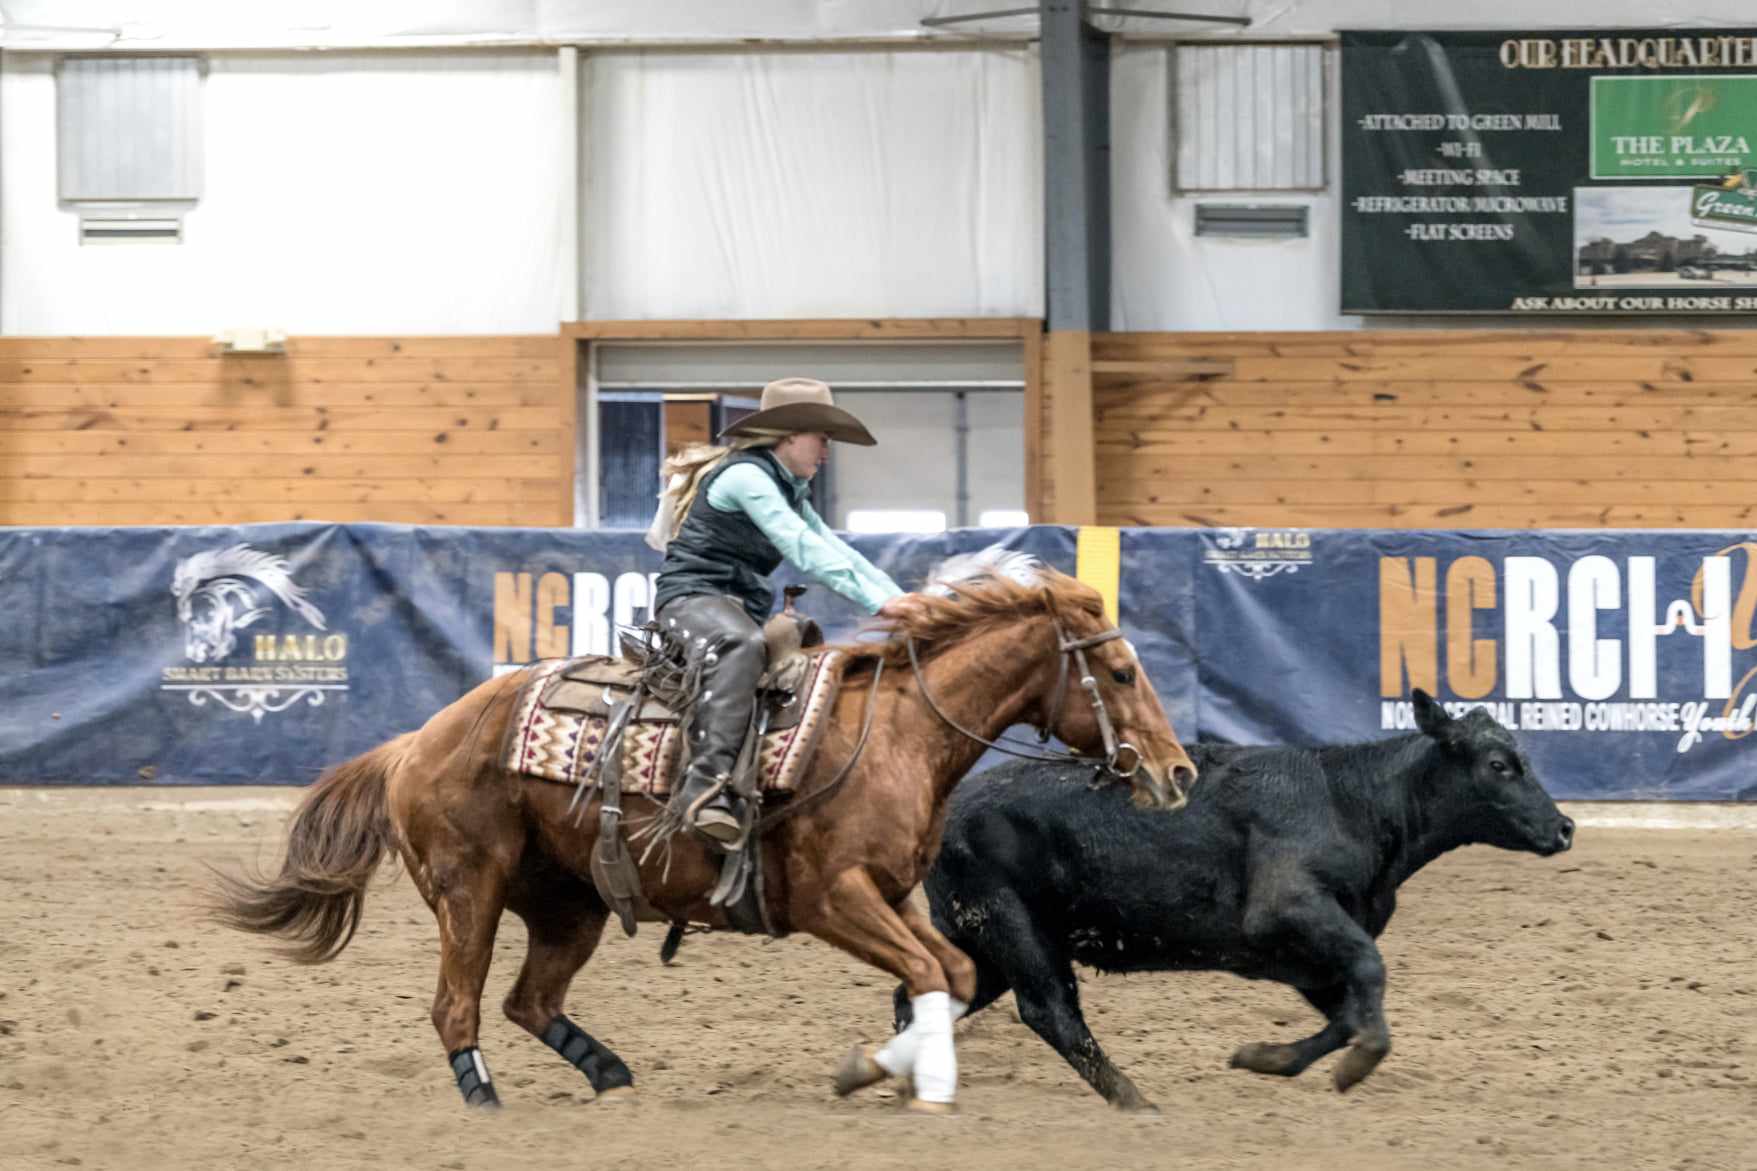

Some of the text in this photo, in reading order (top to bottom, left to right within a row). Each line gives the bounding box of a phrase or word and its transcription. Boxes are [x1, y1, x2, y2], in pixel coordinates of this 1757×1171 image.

[1499, 39, 1557, 69] OUR
[1357, 114, 1563, 131] -ATTACHED TO GREEN MILL
[1610, 135, 1751, 154] THE PLAZA
[1619, 158, 1668, 166] HOTEL
[1691, 158, 1742, 166] SUITES
[1397, 169, 1521, 186] -MEETING SPACE
[1470, 196, 1568, 213] MICROWAVE
[1404, 223, 1515, 240] -FLAT SCREENS
[1511, 296, 1548, 310] ASK
[1551, 296, 1619, 310] ABOUT
[1619, 296, 1664, 310] OUR
[1667, 296, 1732, 310] HORSE
[493, 571, 662, 663] NCRC
[255, 634, 347, 661] HALO
[1521, 702, 1582, 731] REINED
[1584, 702, 1679, 732] COWHORSE
